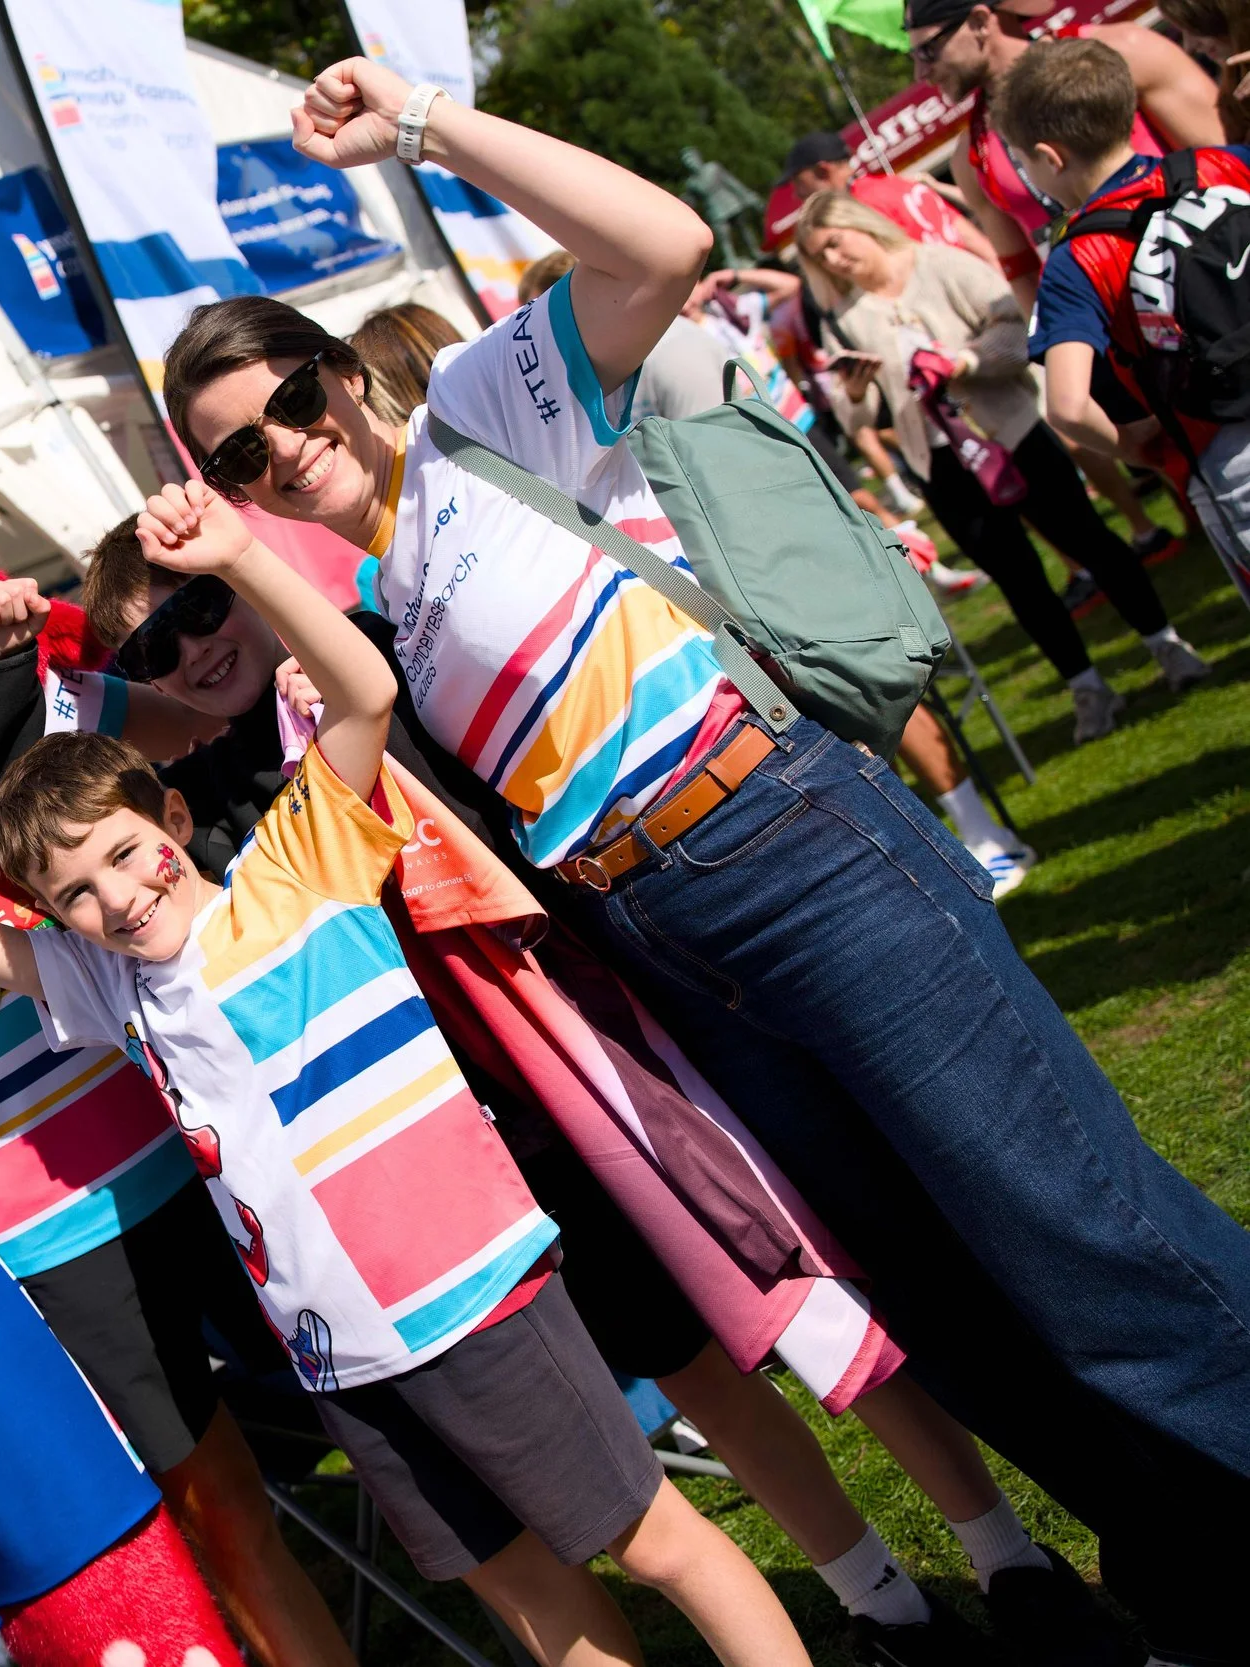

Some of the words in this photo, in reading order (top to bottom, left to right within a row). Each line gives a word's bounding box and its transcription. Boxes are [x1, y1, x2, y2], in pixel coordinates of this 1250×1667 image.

[427, 551, 479, 639] research
[404, 852, 448, 871] WALES
[425, 881, 436, 893] to
[436, 875, 464, 889] donate
